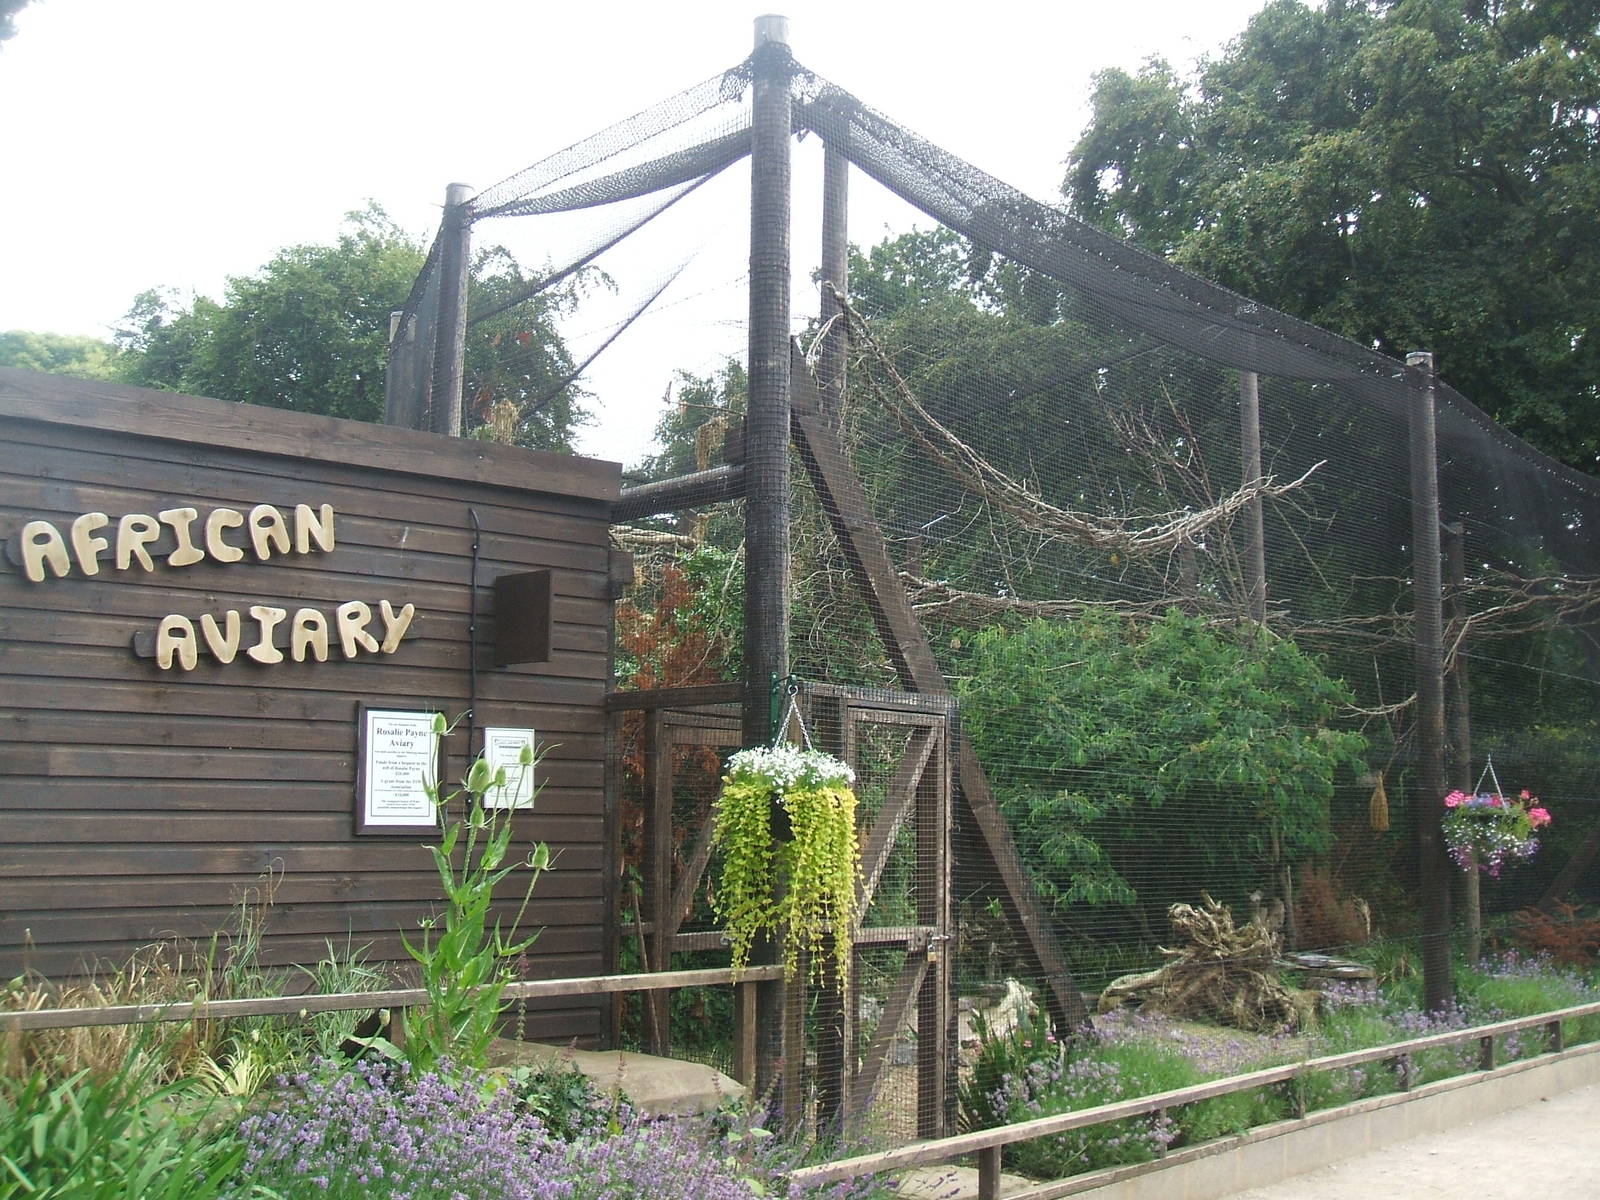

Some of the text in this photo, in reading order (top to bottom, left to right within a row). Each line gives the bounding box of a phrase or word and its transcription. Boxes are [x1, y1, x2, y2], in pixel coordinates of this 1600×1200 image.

[21, 503, 335, 583] AFRICAN
[155, 599, 416, 671] AVIARY
[376, 727, 428, 738] Rosalie Payne
[389, 739, 414, 749] Aviary
